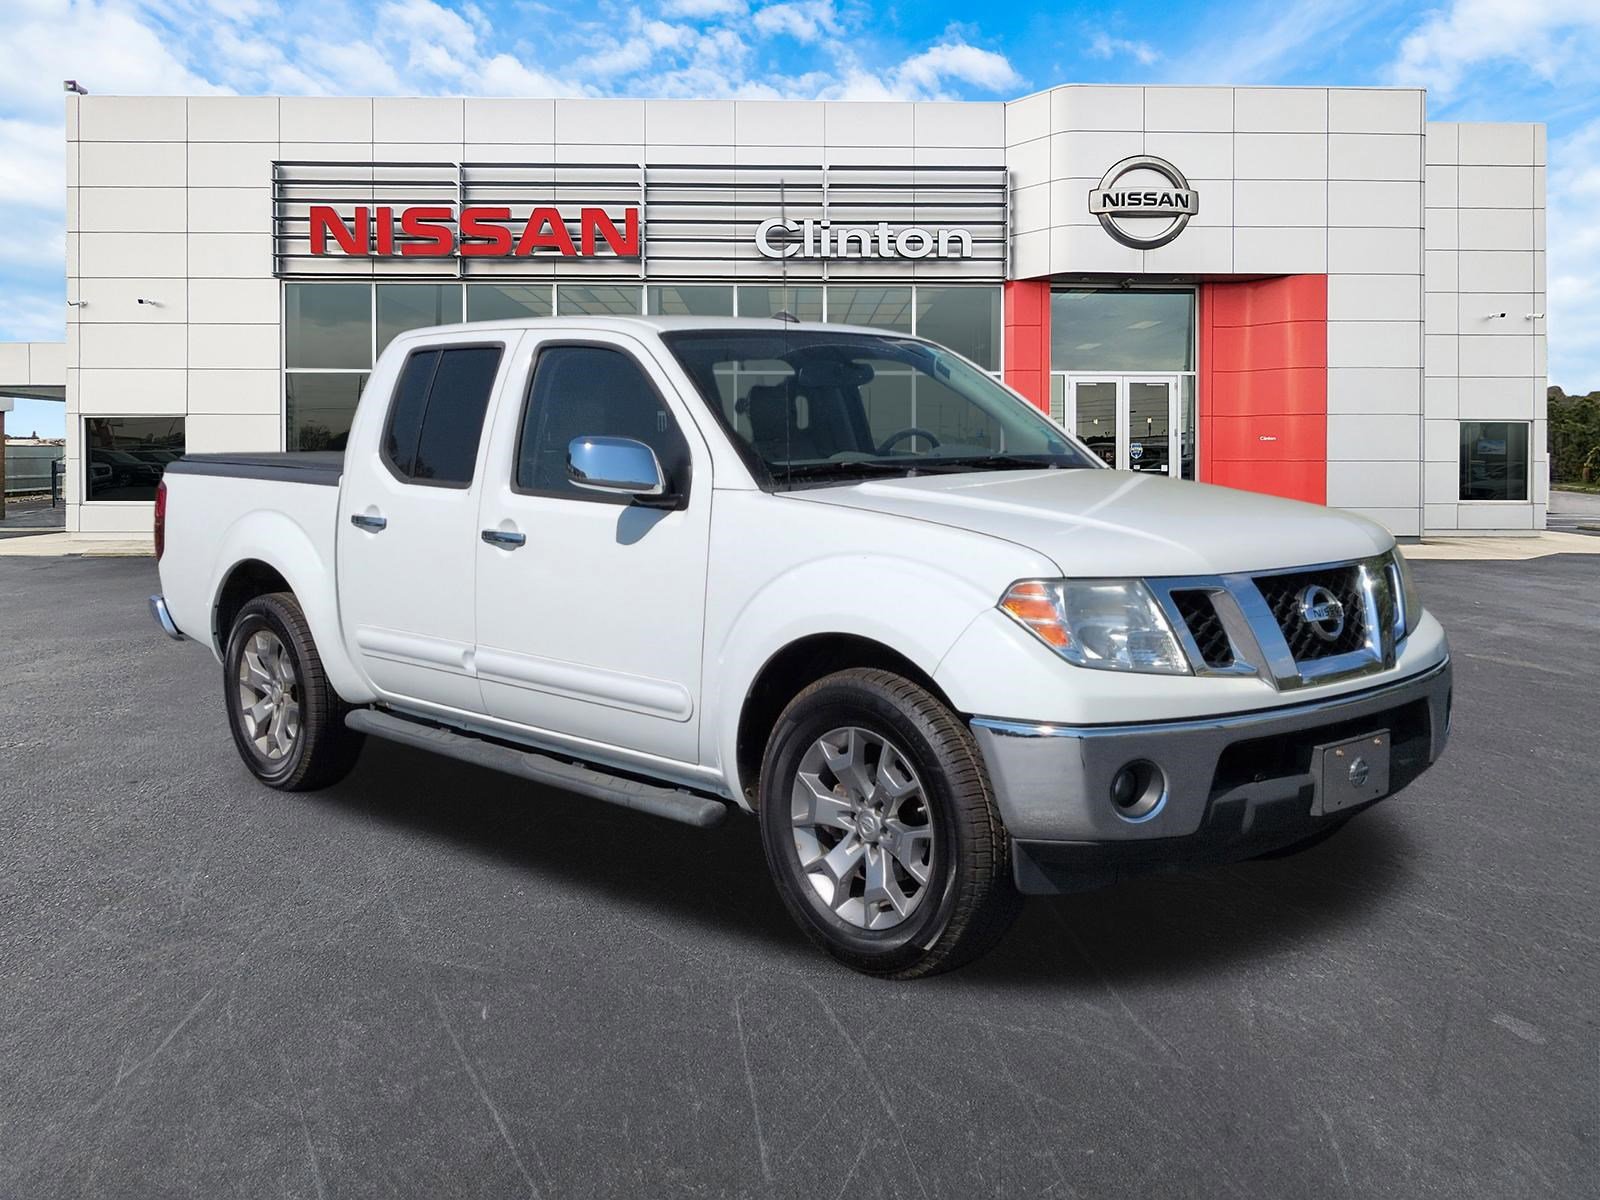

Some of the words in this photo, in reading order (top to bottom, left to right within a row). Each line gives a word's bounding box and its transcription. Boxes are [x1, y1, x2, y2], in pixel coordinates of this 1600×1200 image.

[1102, 192, 1189, 208] NISSAN
[310, 206, 640, 257] NISSAN
[755, 217, 972, 258] Clinton
